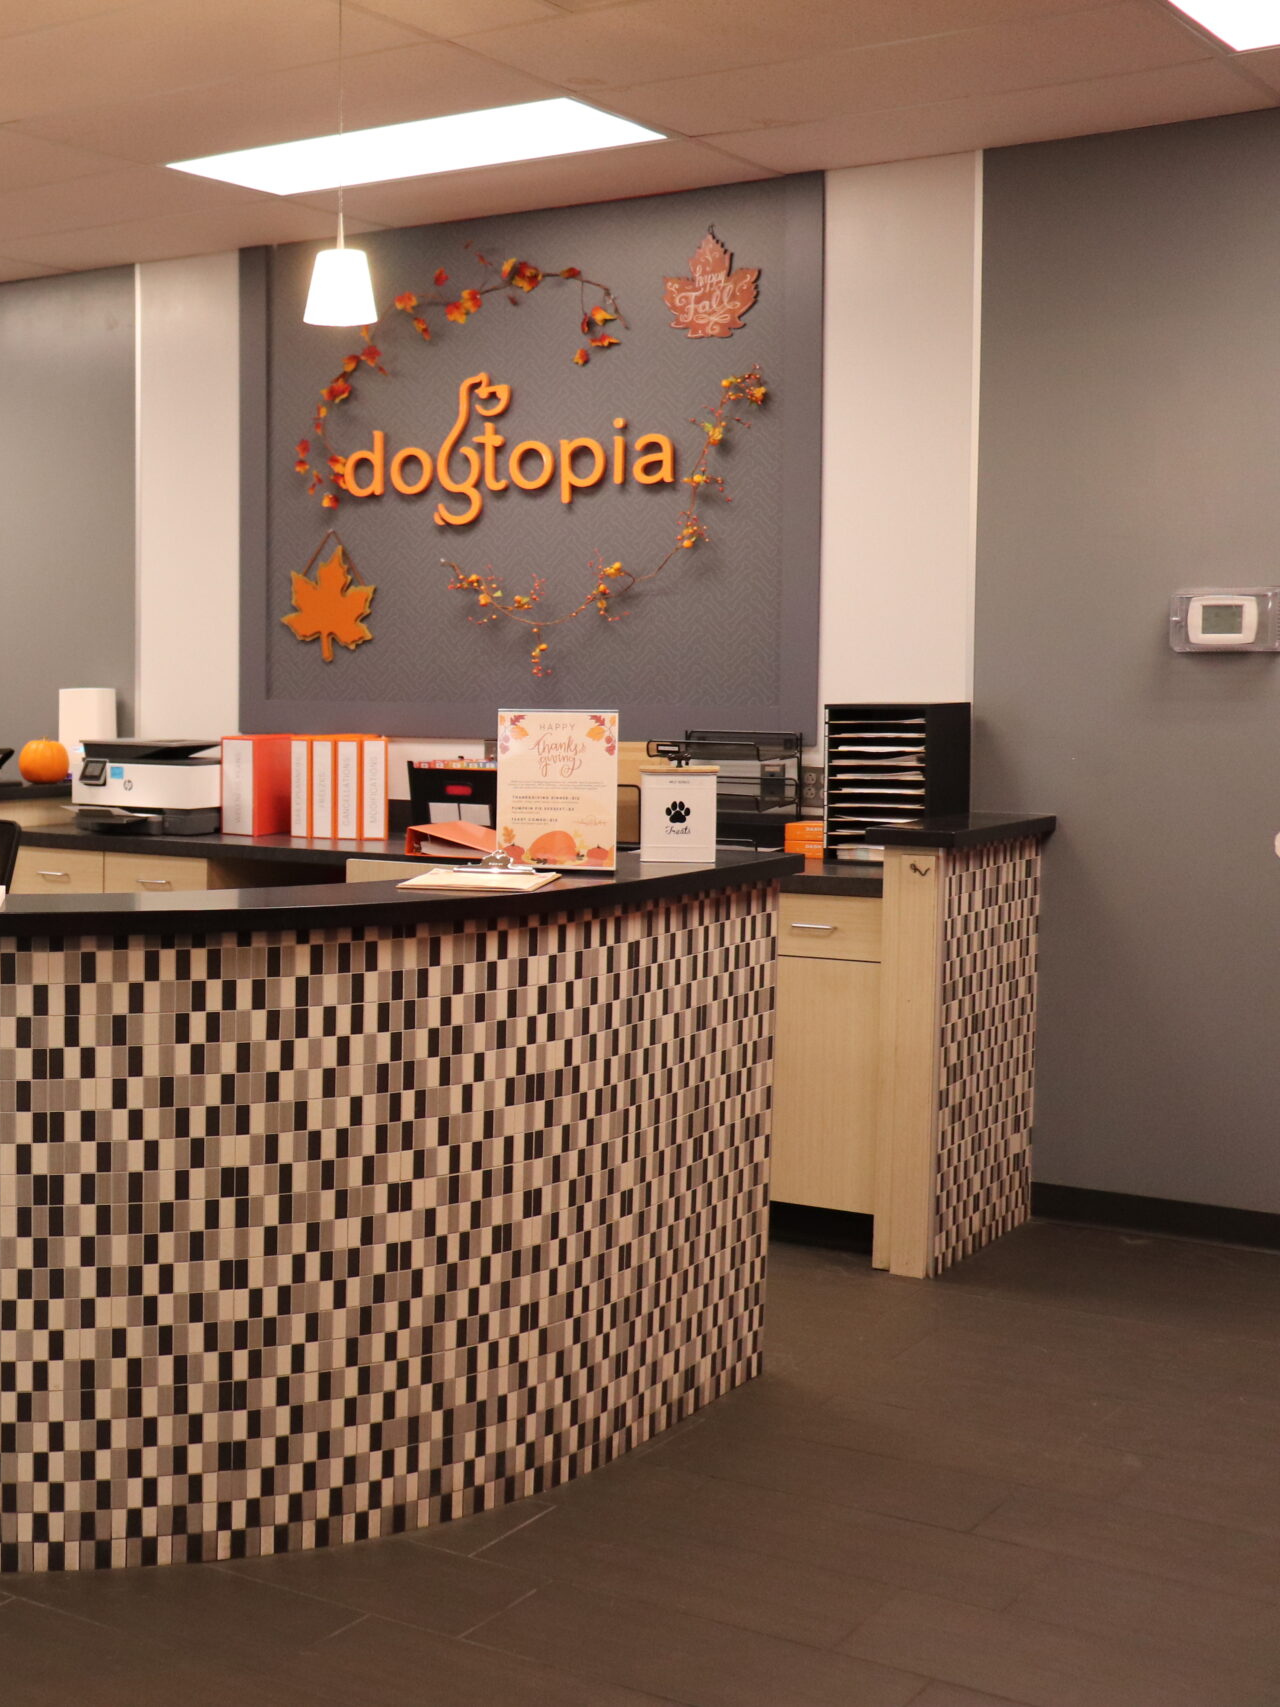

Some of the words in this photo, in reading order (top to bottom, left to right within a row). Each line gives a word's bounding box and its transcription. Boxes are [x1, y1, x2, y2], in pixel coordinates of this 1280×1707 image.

[675, 283, 741, 323] Fall
[343, 371, 675, 526] dogtopia
[539, 723, 575, 731] HAPPY
